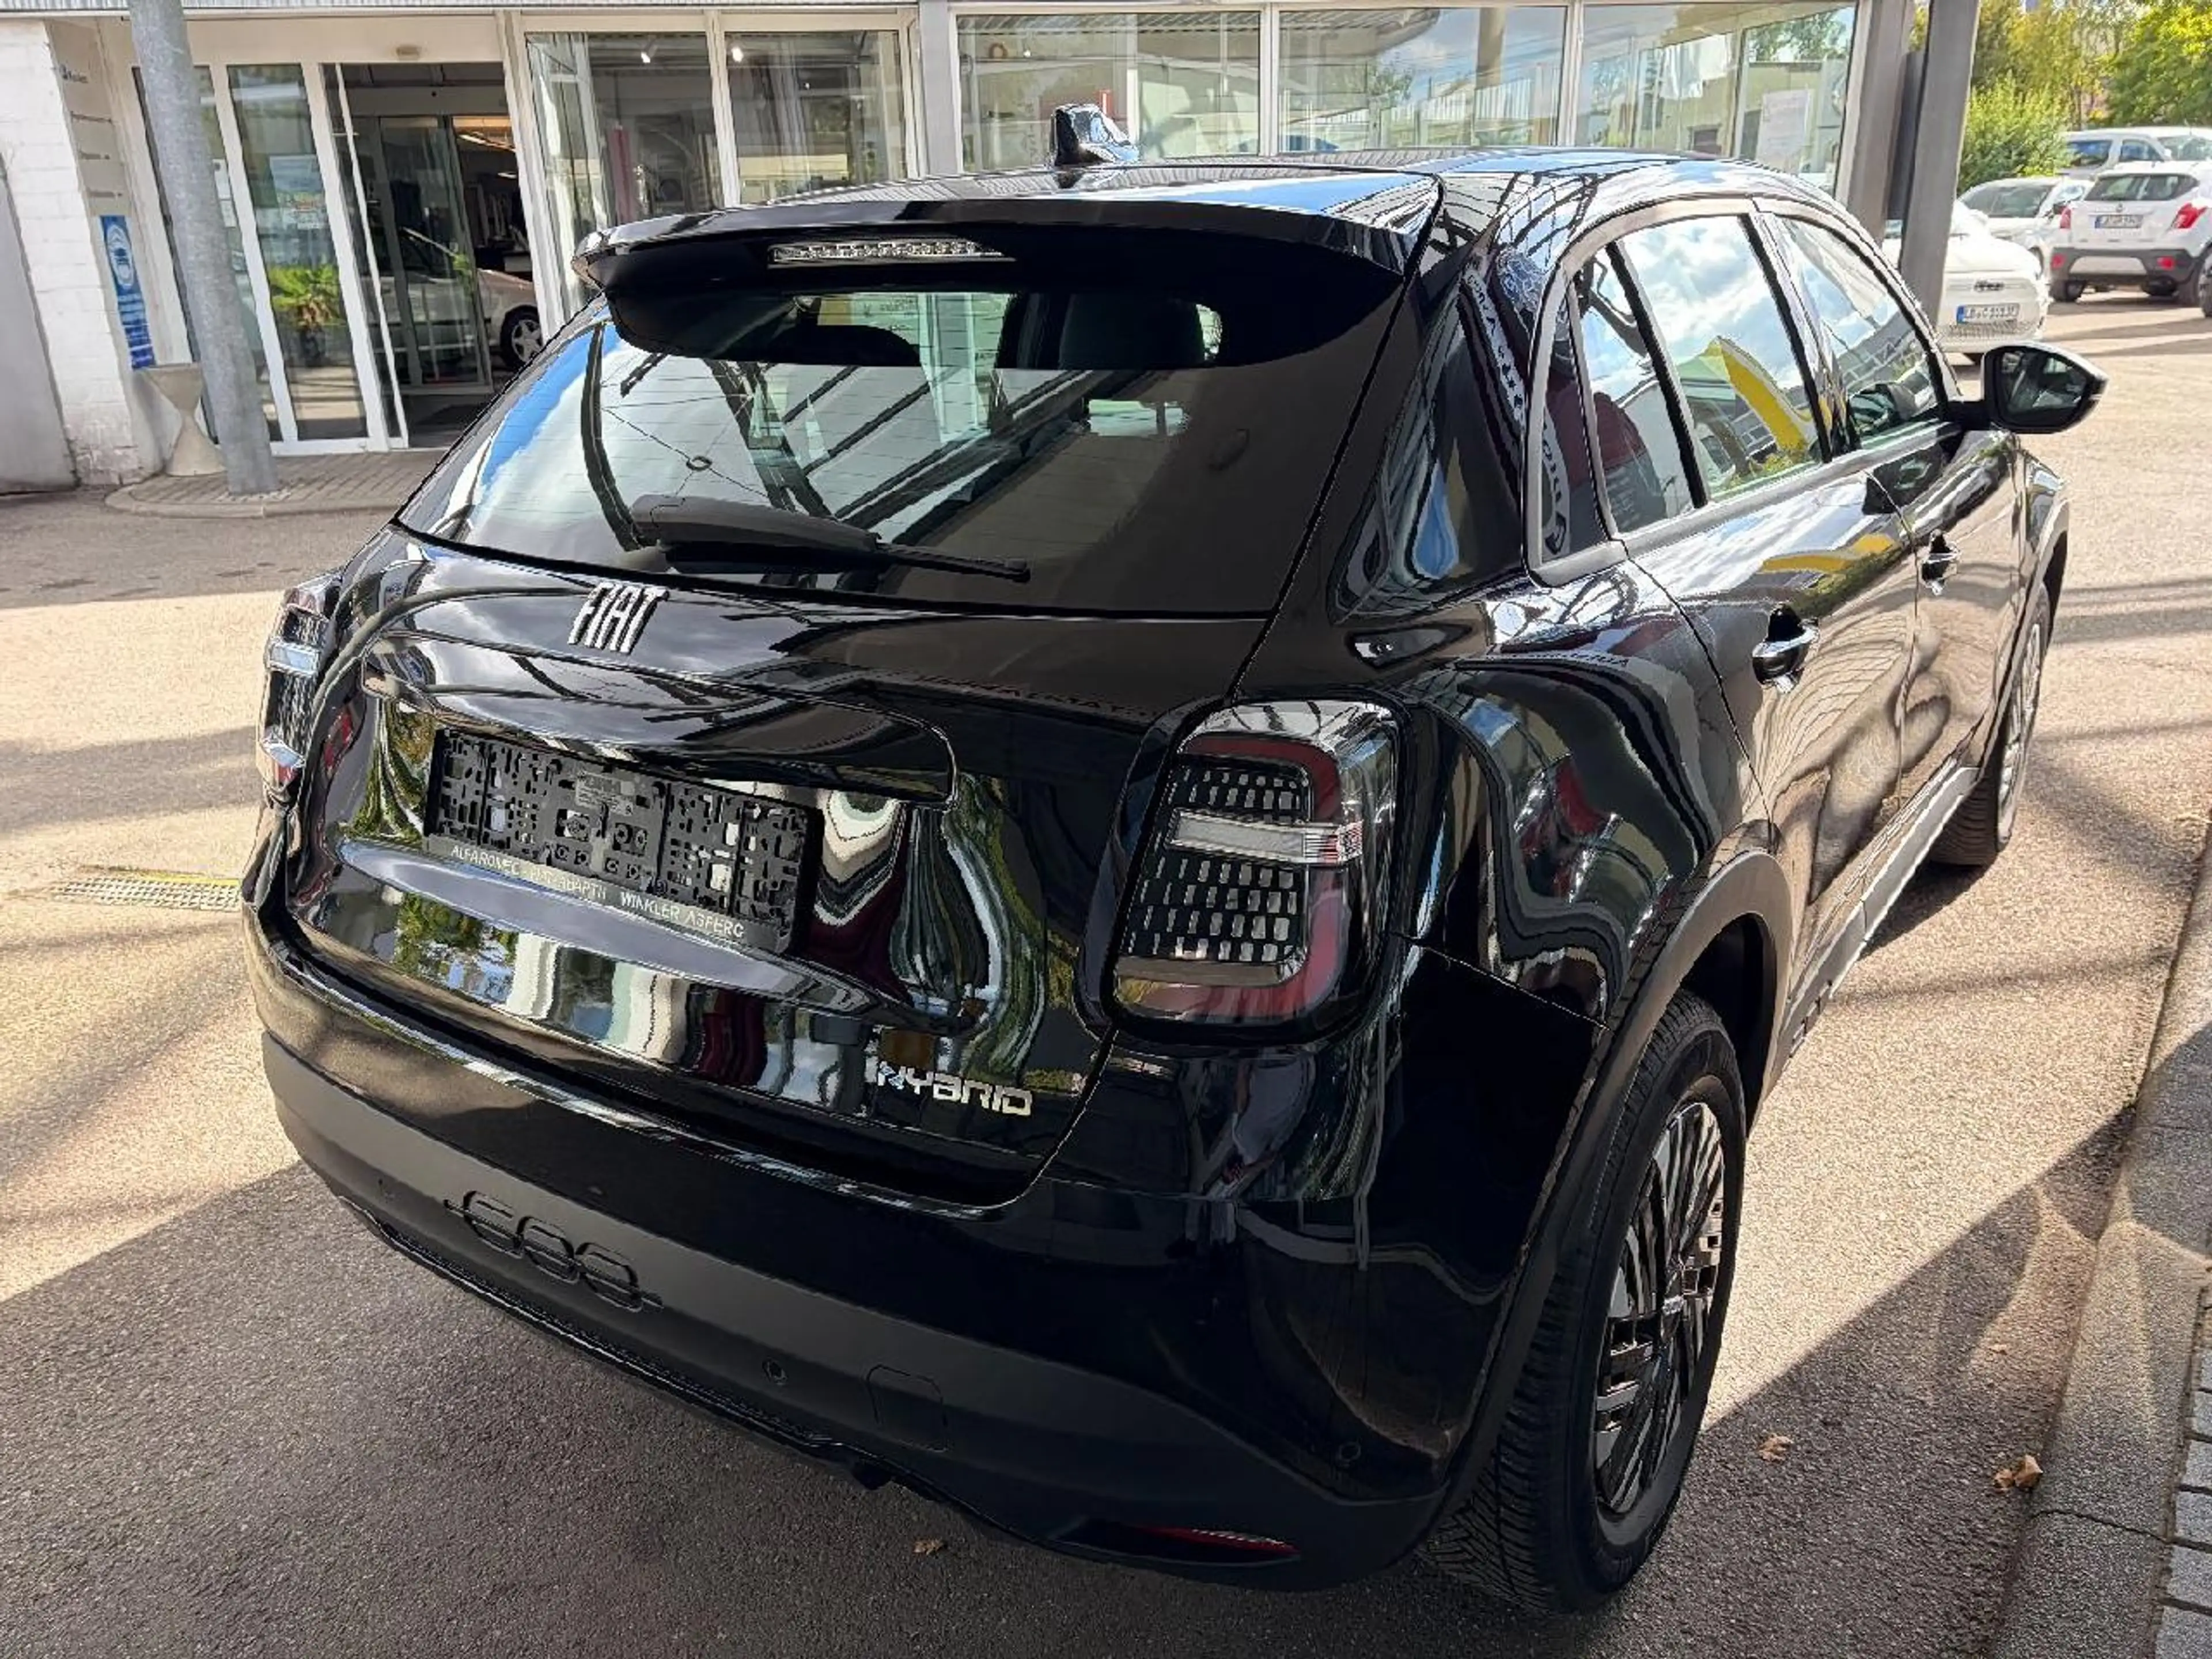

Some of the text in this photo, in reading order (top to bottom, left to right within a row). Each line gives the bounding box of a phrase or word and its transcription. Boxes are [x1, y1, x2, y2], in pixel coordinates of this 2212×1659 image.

[567, 582, 669, 656] FIAT
[620, 891, 680, 921] WINKLER
[877, 1060, 1033, 1116] HYBRID
[455, 1190, 651, 1314] 600
